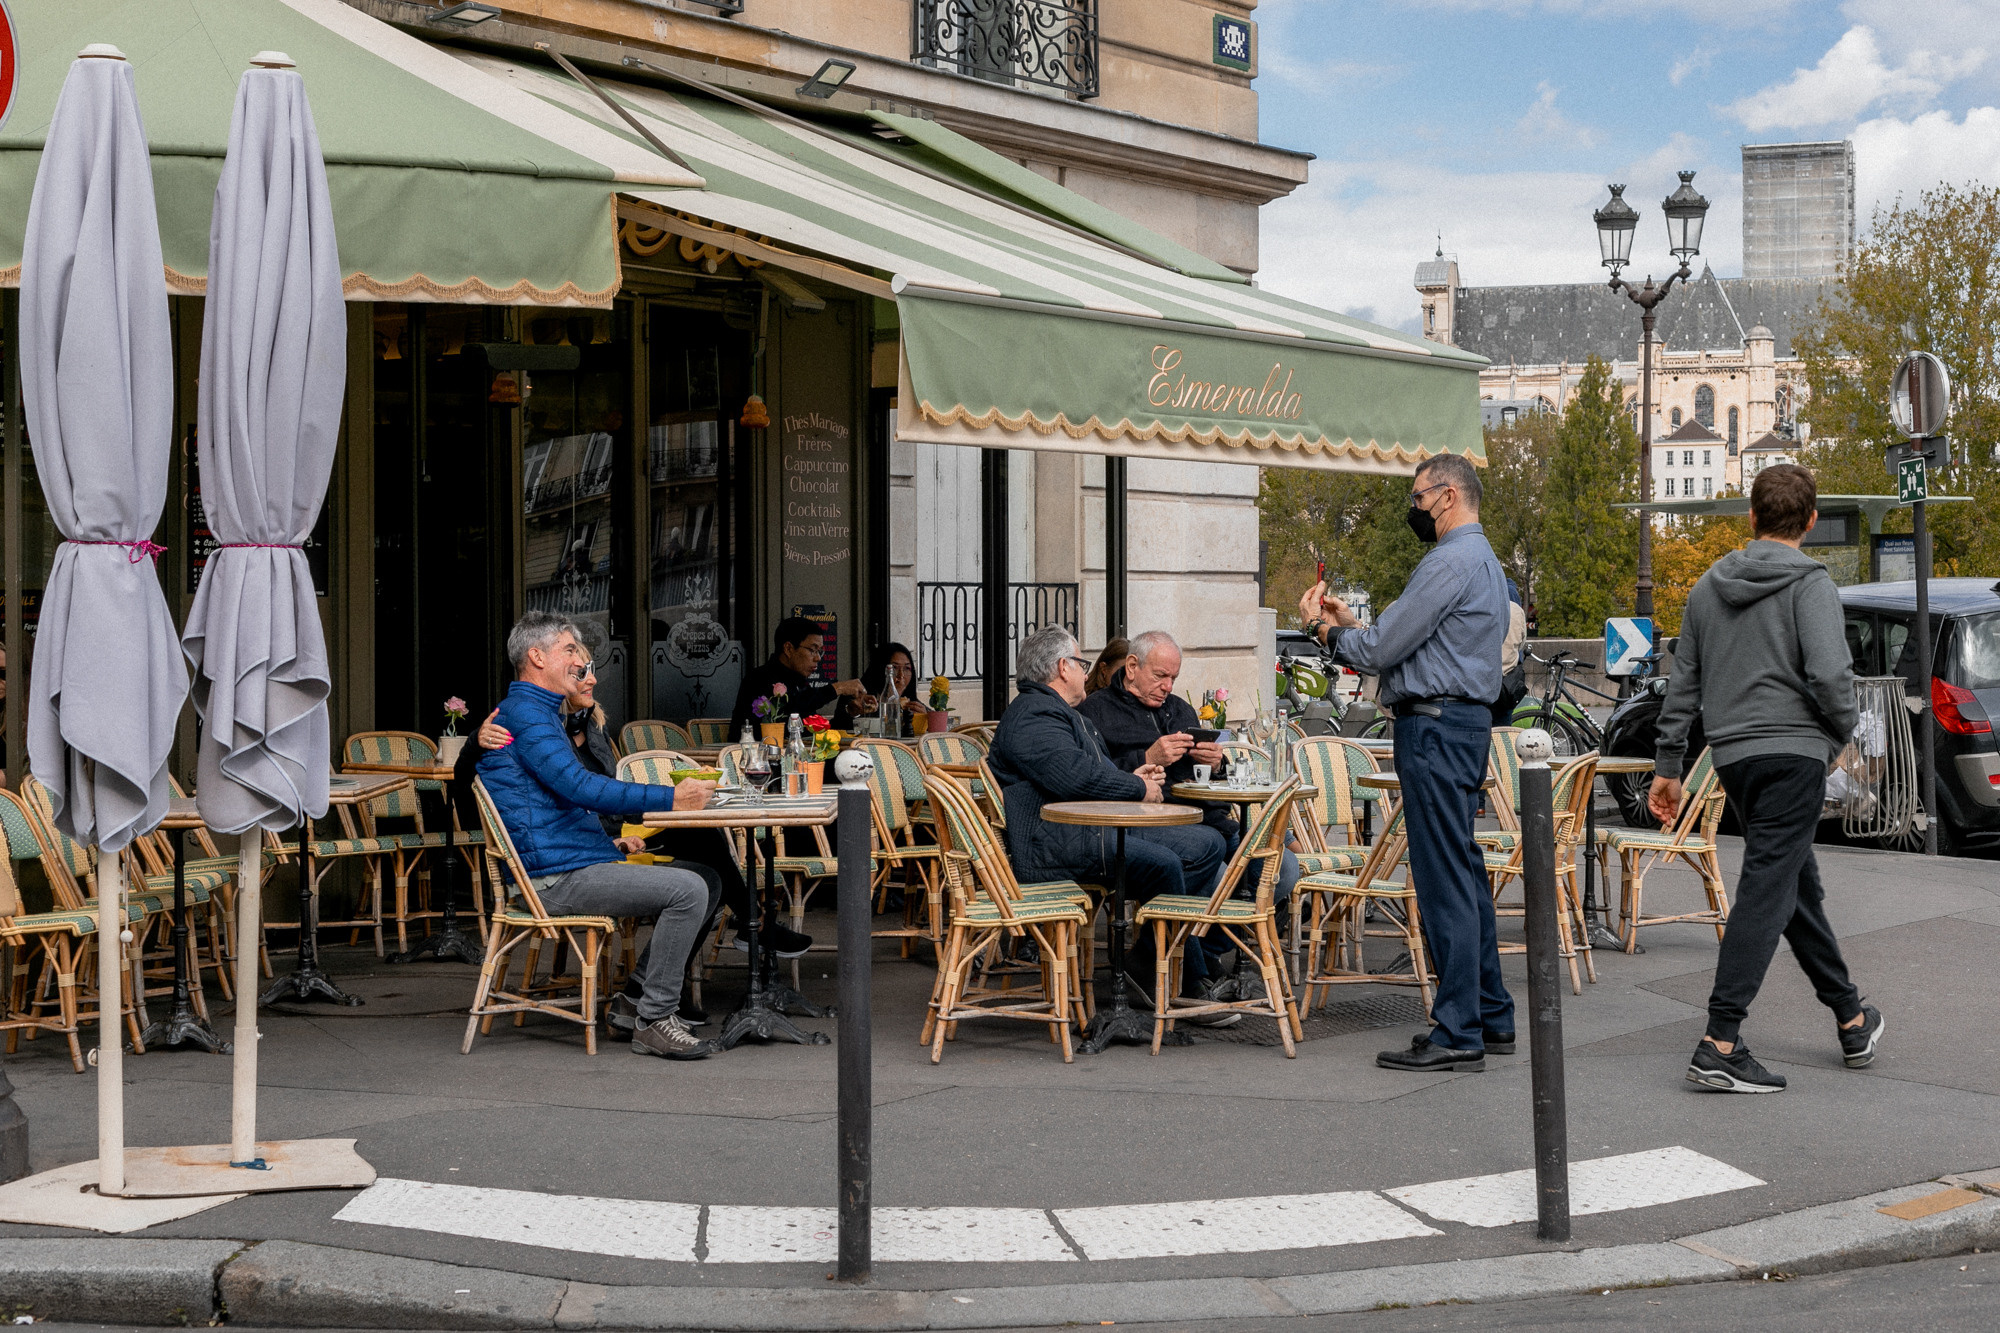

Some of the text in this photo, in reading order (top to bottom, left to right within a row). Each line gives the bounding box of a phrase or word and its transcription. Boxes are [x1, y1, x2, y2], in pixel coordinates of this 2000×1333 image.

[1147, 344, 1304, 420] Esmeralda
[809, 412, 849, 439] Mariage
[797, 434, 833, 452] Frères
[784, 455, 849, 474] Cappuccino
[789, 475, 840, 494] Chocolat
[788, 501, 842, 518] Cocktails
[812, 546, 850, 566] Pression
[686, 641, 710, 653] Pizzas
